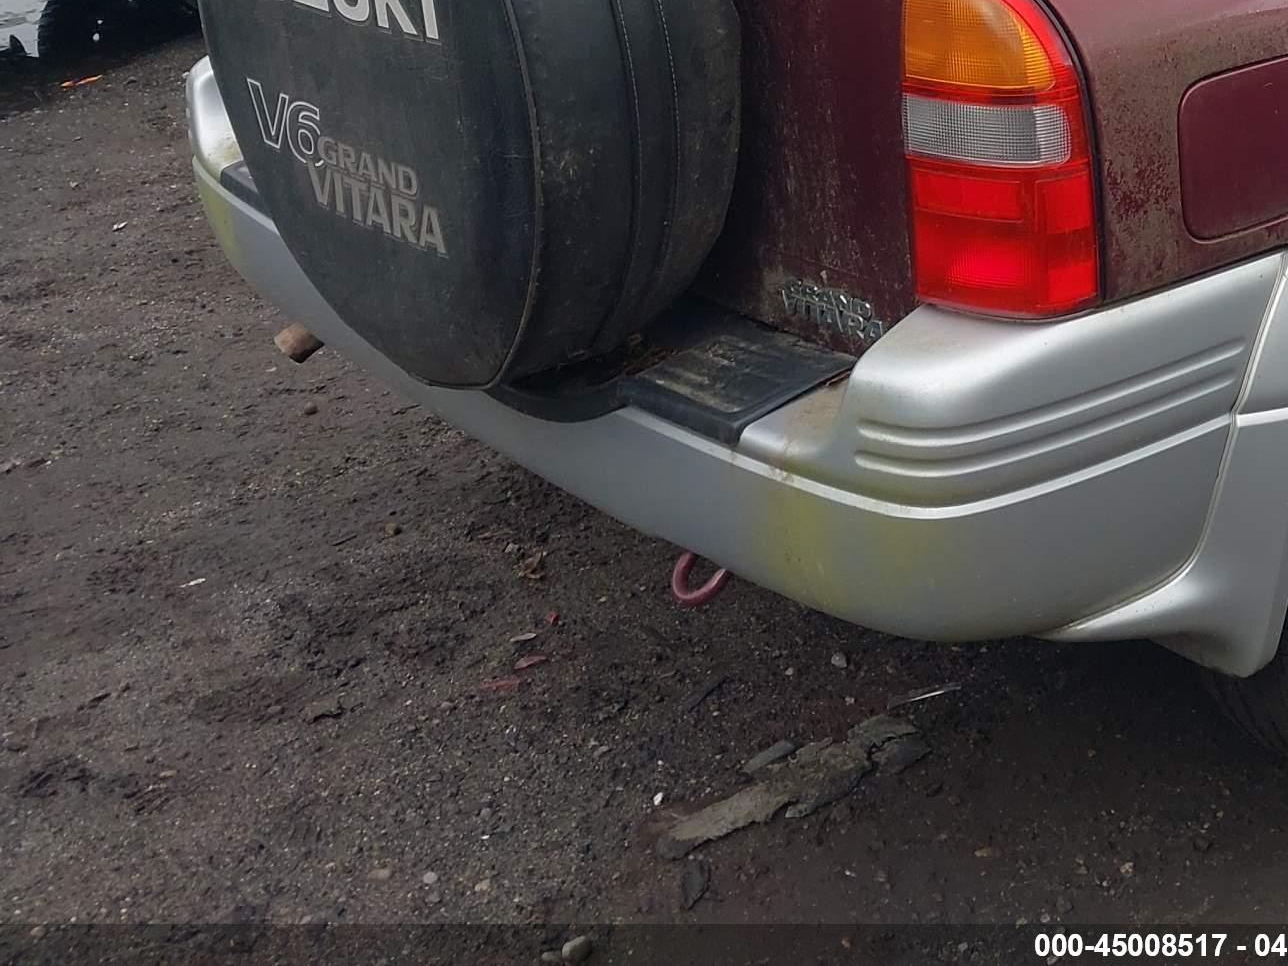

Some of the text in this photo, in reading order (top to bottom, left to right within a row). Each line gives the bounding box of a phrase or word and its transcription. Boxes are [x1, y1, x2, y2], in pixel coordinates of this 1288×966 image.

[246, 76, 325, 168] V6
[317, 134, 420, 198] GRAND
[307, 164, 448, 258] VITARA
